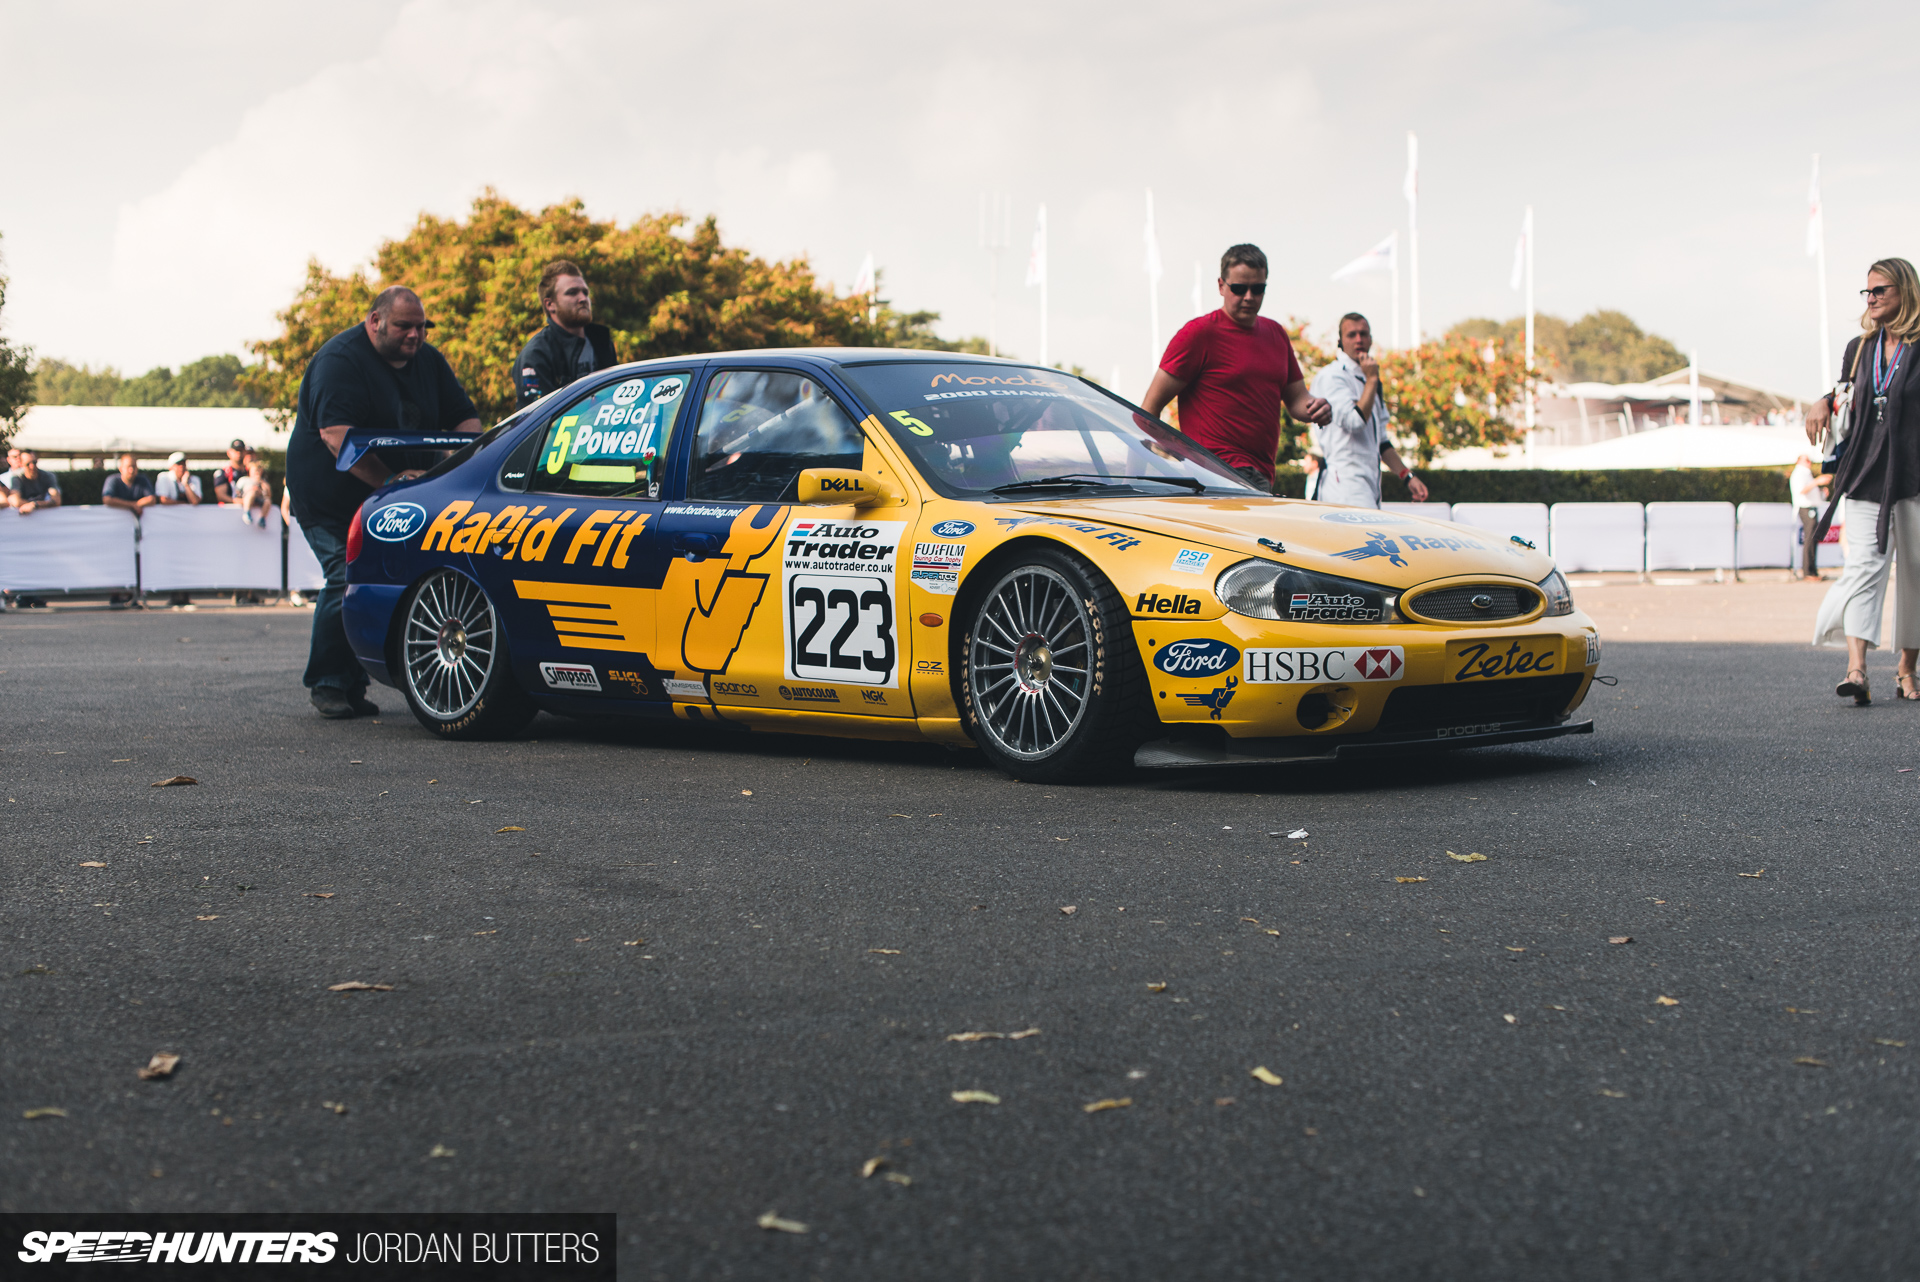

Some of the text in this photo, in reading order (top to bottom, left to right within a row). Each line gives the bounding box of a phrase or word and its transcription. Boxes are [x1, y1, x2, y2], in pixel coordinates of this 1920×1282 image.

[931, 373, 1068, 390] Mondeo
[618, 386, 640, 397] 223
[923, 390, 988, 401] 2000
[594, 402, 650, 426] Reid
[888, 409, 934, 437] 5
[547, 415, 579, 474] 5
[571, 423, 656, 455] Powell
[821, 478, 864, 492] DELL
[376, 506, 411, 533] Ford
[938, 521, 968, 535] Ford
[421, 500, 652, 569] Rapid Fit
[809, 524, 879, 539] Auto
[787, 540, 894, 560] Trader
[914, 543, 966, 556] FUJIFILM
[1095, 532, 1142, 551] Fit
[1179, 549, 1209, 561] PSP
[784, 560, 893, 573] www.autotrader.co.uk
[1135, 593, 1202, 615] Hella
[1308, 593, 1365, 606] Auto
[1289, 606, 1380, 620] Trader
[795, 586, 896, 672] 223
[1163, 643, 1227, 672] Ford
[1246, 650, 1346, 682] HSBC
[1455, 641, 1555, 681] Zetec
[545, 666, 596, 686] Simpson
[713, 681, 758, 695] sparco
[791, 687, 838, 699] AUTOCOLOR
[861, 689, 887, 703] NGK
